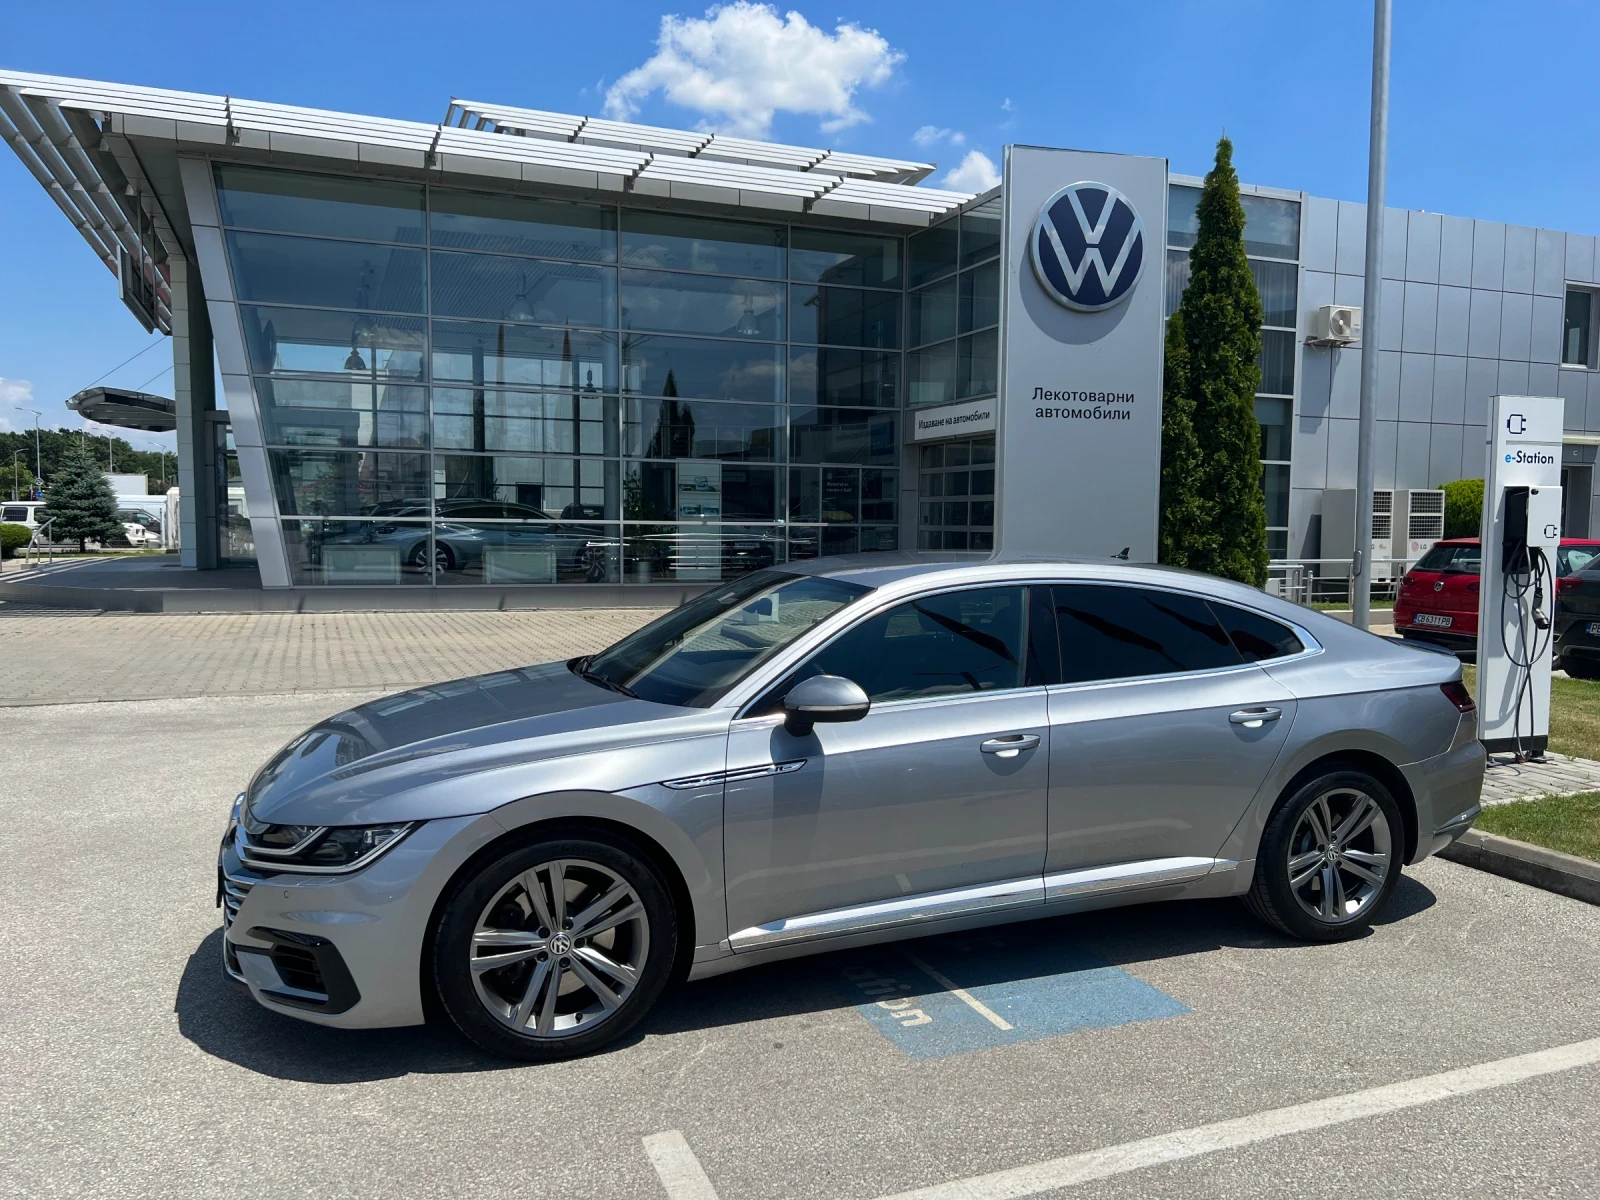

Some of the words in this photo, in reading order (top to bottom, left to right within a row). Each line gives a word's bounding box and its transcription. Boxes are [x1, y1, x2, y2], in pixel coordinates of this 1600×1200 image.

[1032, 386, 1135, 410] Лекотоварни
[918, 418, 945, 430] Издаване
[945, 417, 952, 426] на
[953, 410, 990, 424] автомобили
[1035, 405, 1131, 420] автомобили
[1504, 450, 1554, 465] e-Station
